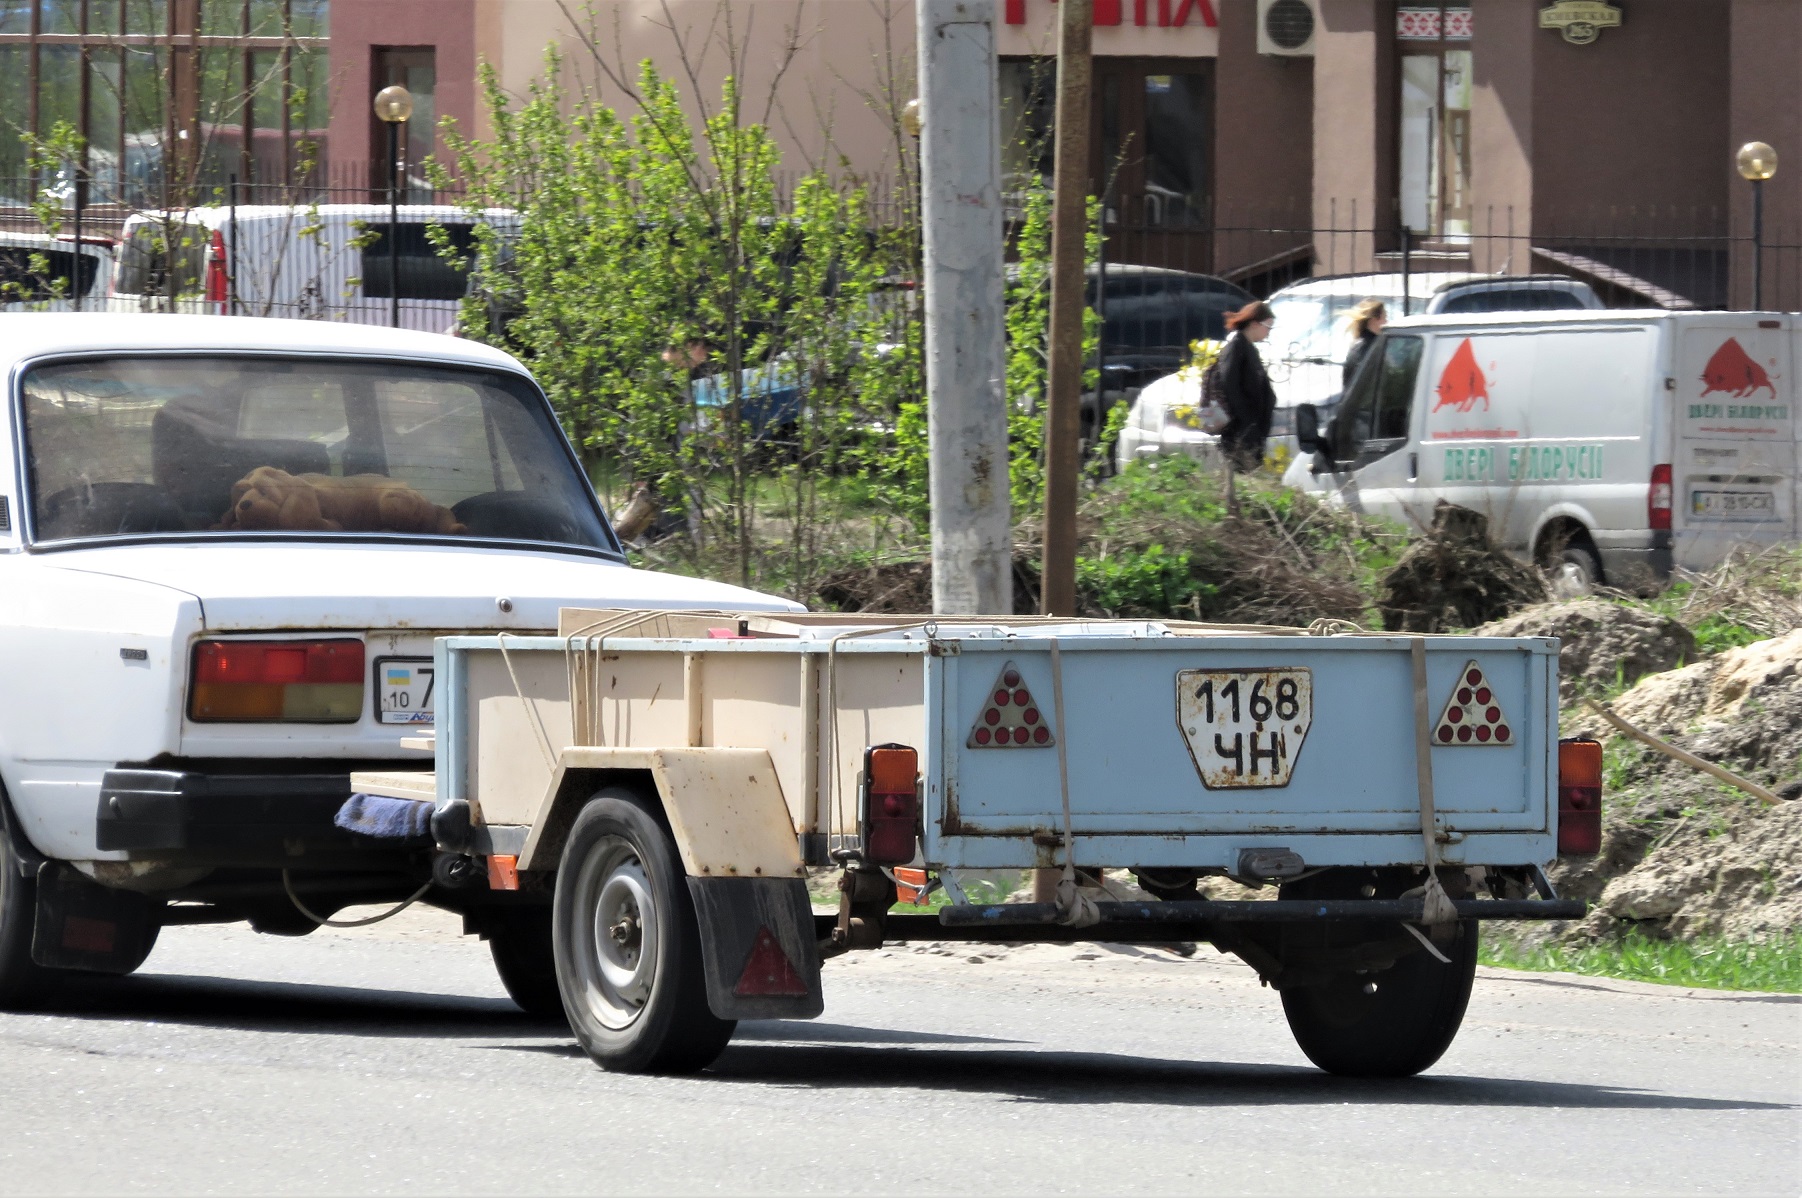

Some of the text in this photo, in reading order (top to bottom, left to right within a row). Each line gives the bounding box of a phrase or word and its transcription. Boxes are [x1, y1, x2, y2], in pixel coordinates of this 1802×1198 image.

[1443, 446, 1495, 481] ДВЕРІ
[390, 691, 409, 708] 10
[1194, 678, 1300, 724] 1168
